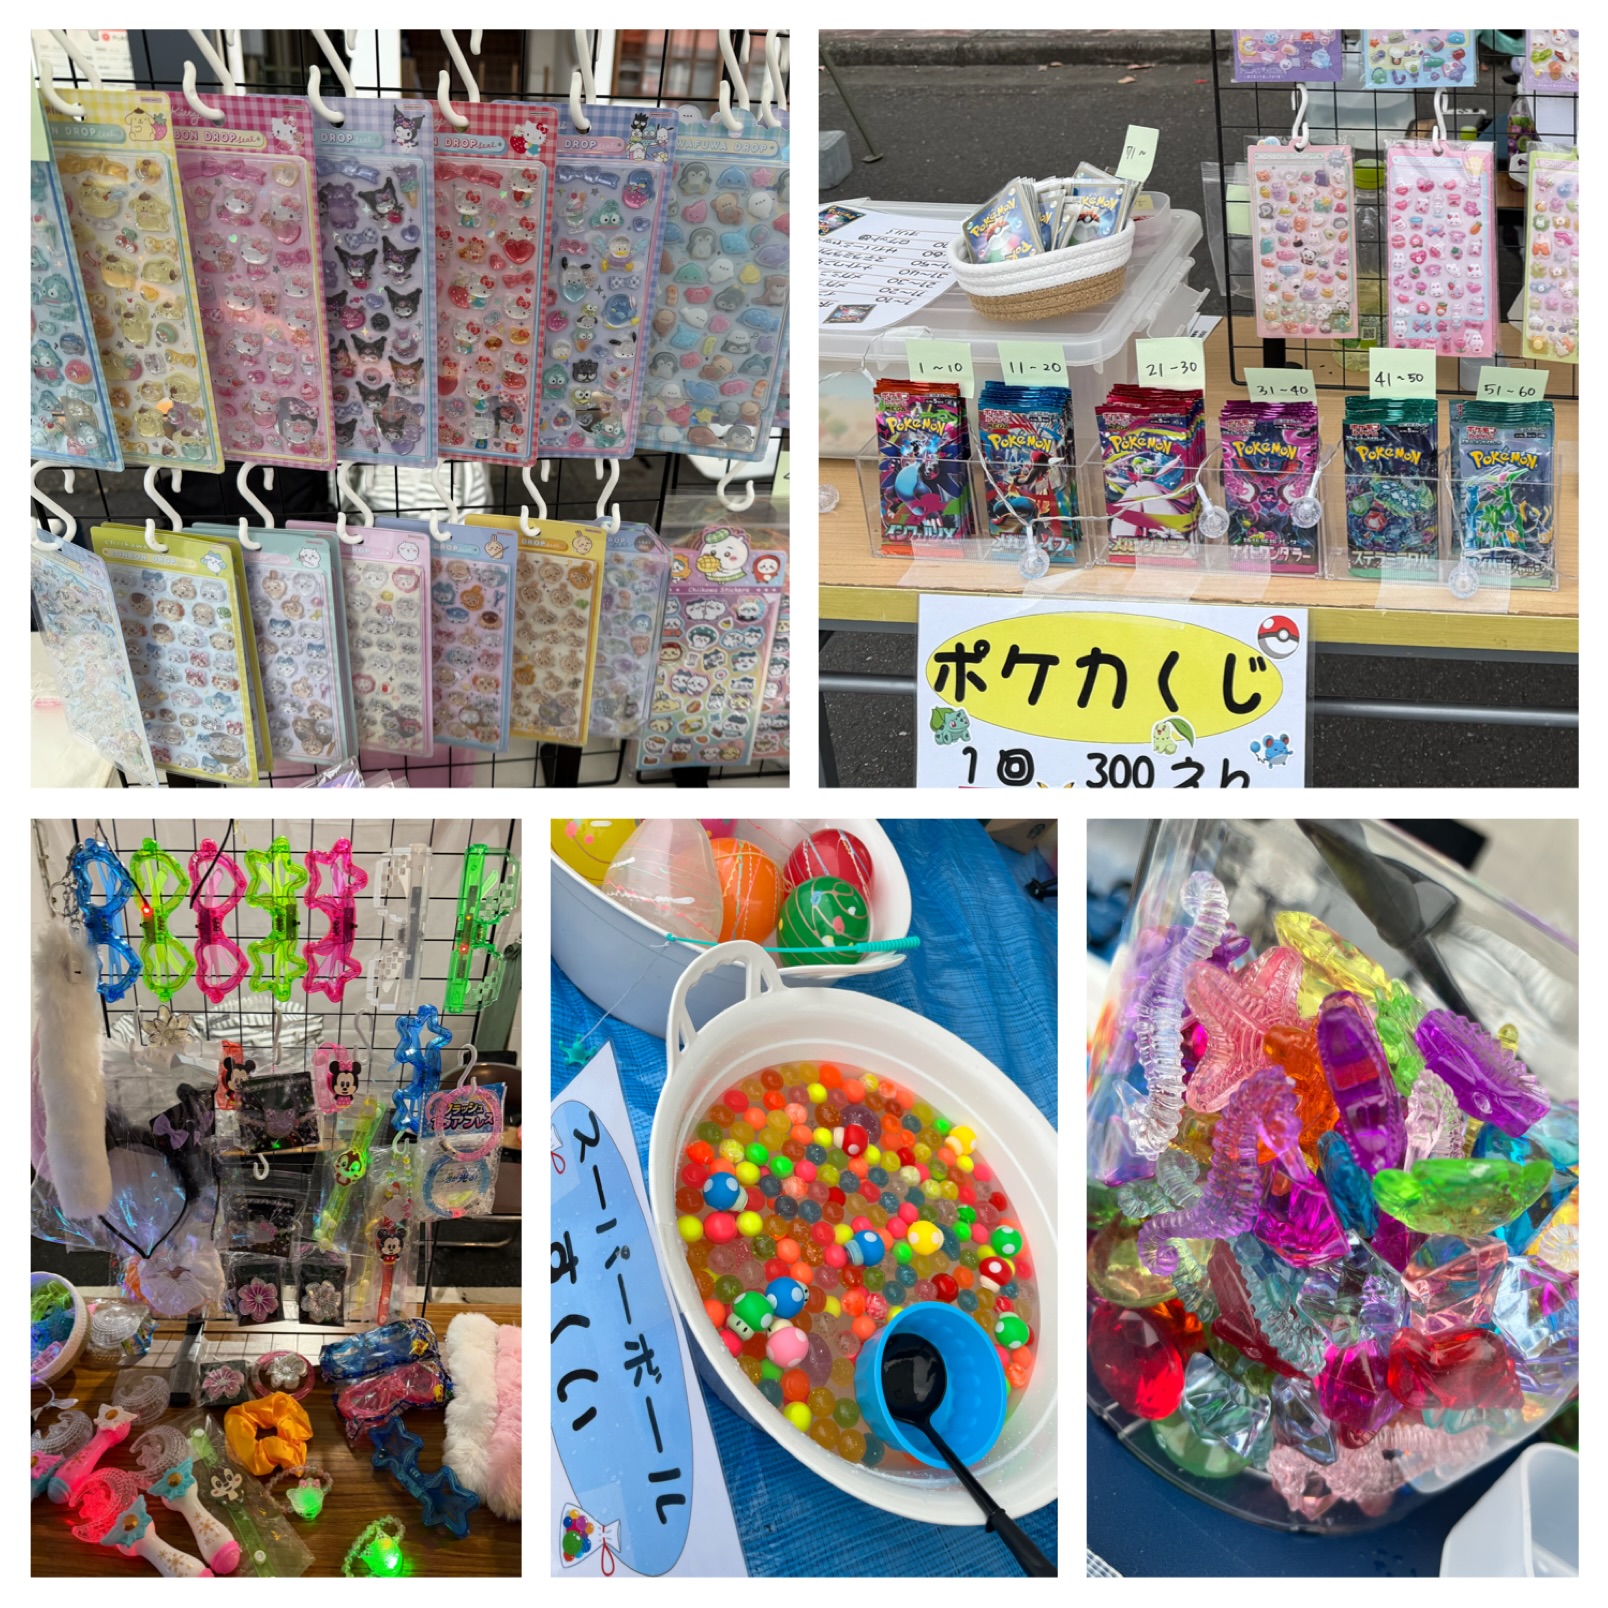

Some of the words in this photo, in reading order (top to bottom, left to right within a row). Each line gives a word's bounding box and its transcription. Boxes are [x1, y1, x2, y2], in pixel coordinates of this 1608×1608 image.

[204, 131, 237, 143] DROP
[321, 132, 353, 143] DROP
[444, 138, 478, 149] DROP
[564, 140, 597, 149] DROP
[734, 143, 768, 153] DROP
[521, 538, 546, 547] DROP
[933, 639, 1268, 715] ポケカくじ
[962, 746, 1035, 787] 1回
[573, 1110, 687, 1526] スーパーボール
